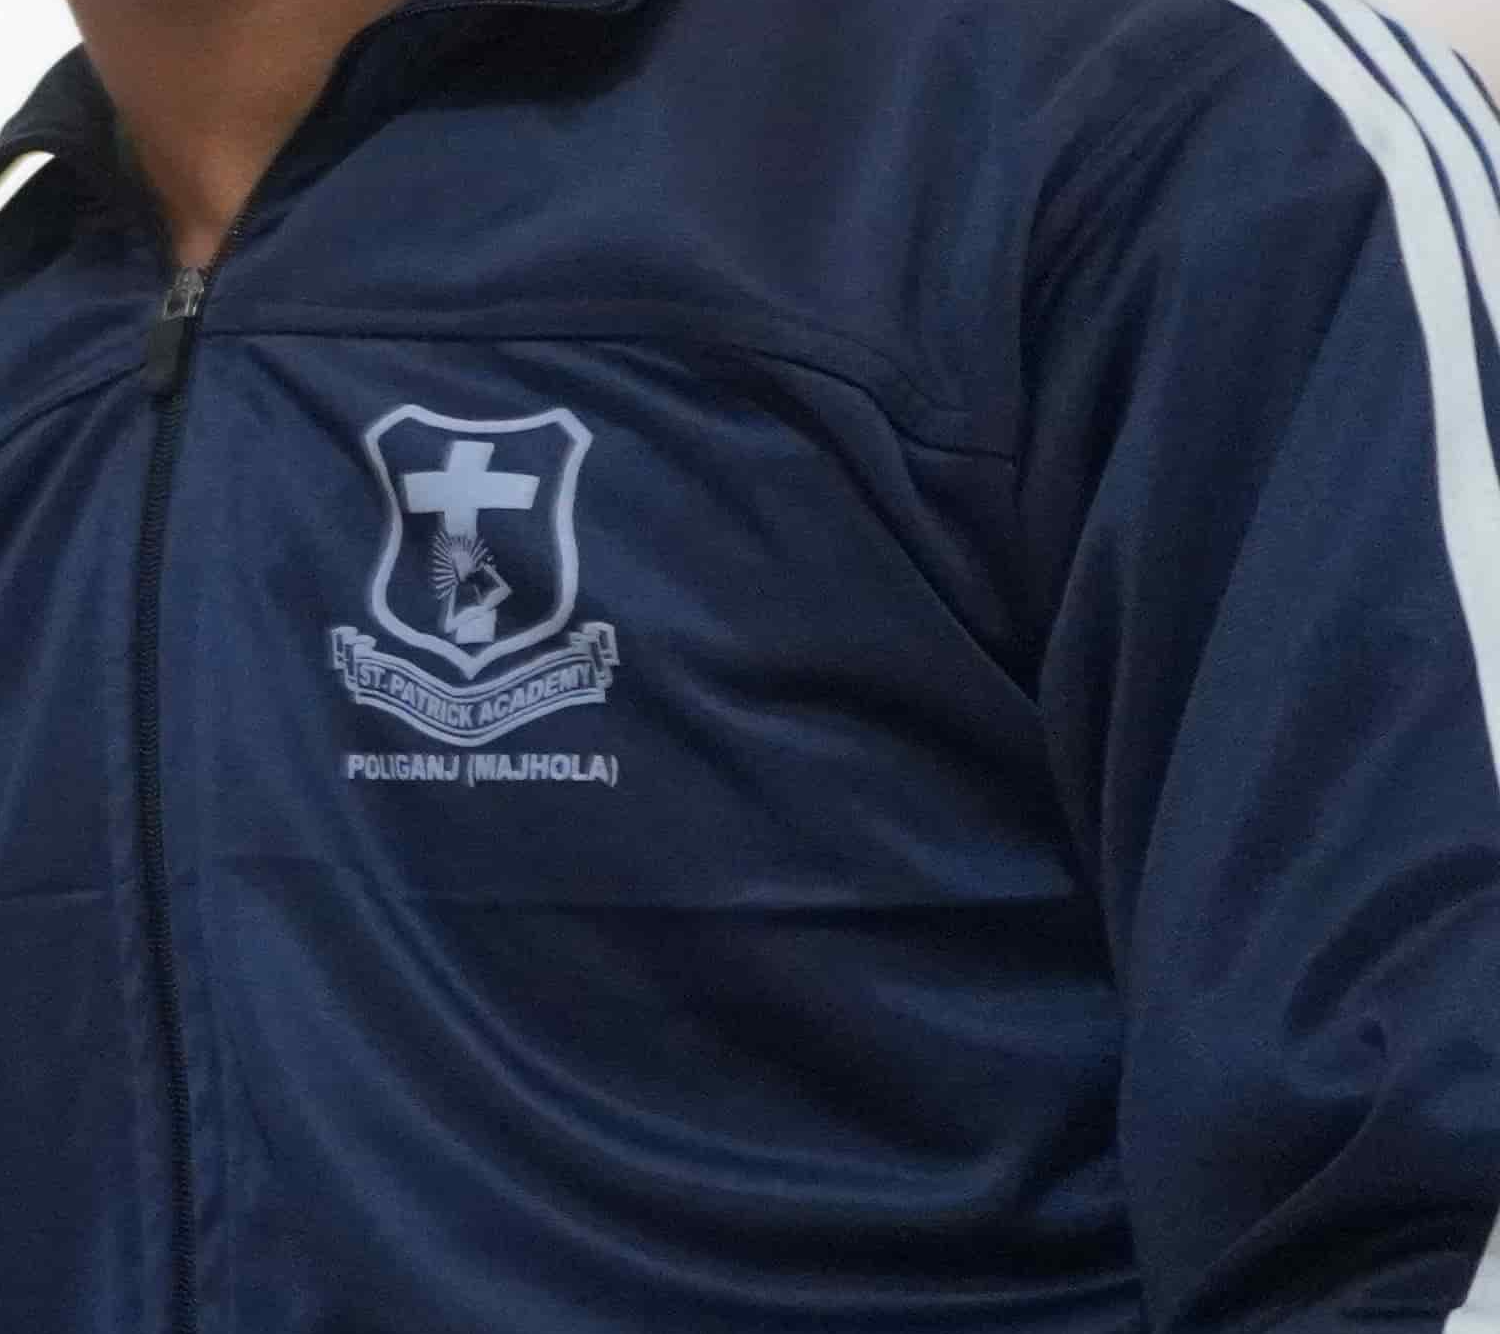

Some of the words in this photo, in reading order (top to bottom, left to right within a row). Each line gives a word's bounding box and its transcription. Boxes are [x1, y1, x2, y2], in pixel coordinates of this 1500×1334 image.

[388, 678, 474, 728] PATRICK
[479, 663, 591, 725] ACADEMY
[348, 754, 460, 780] POLIGANJ
[467, 754, 620, 787] (MAJHOLA)
